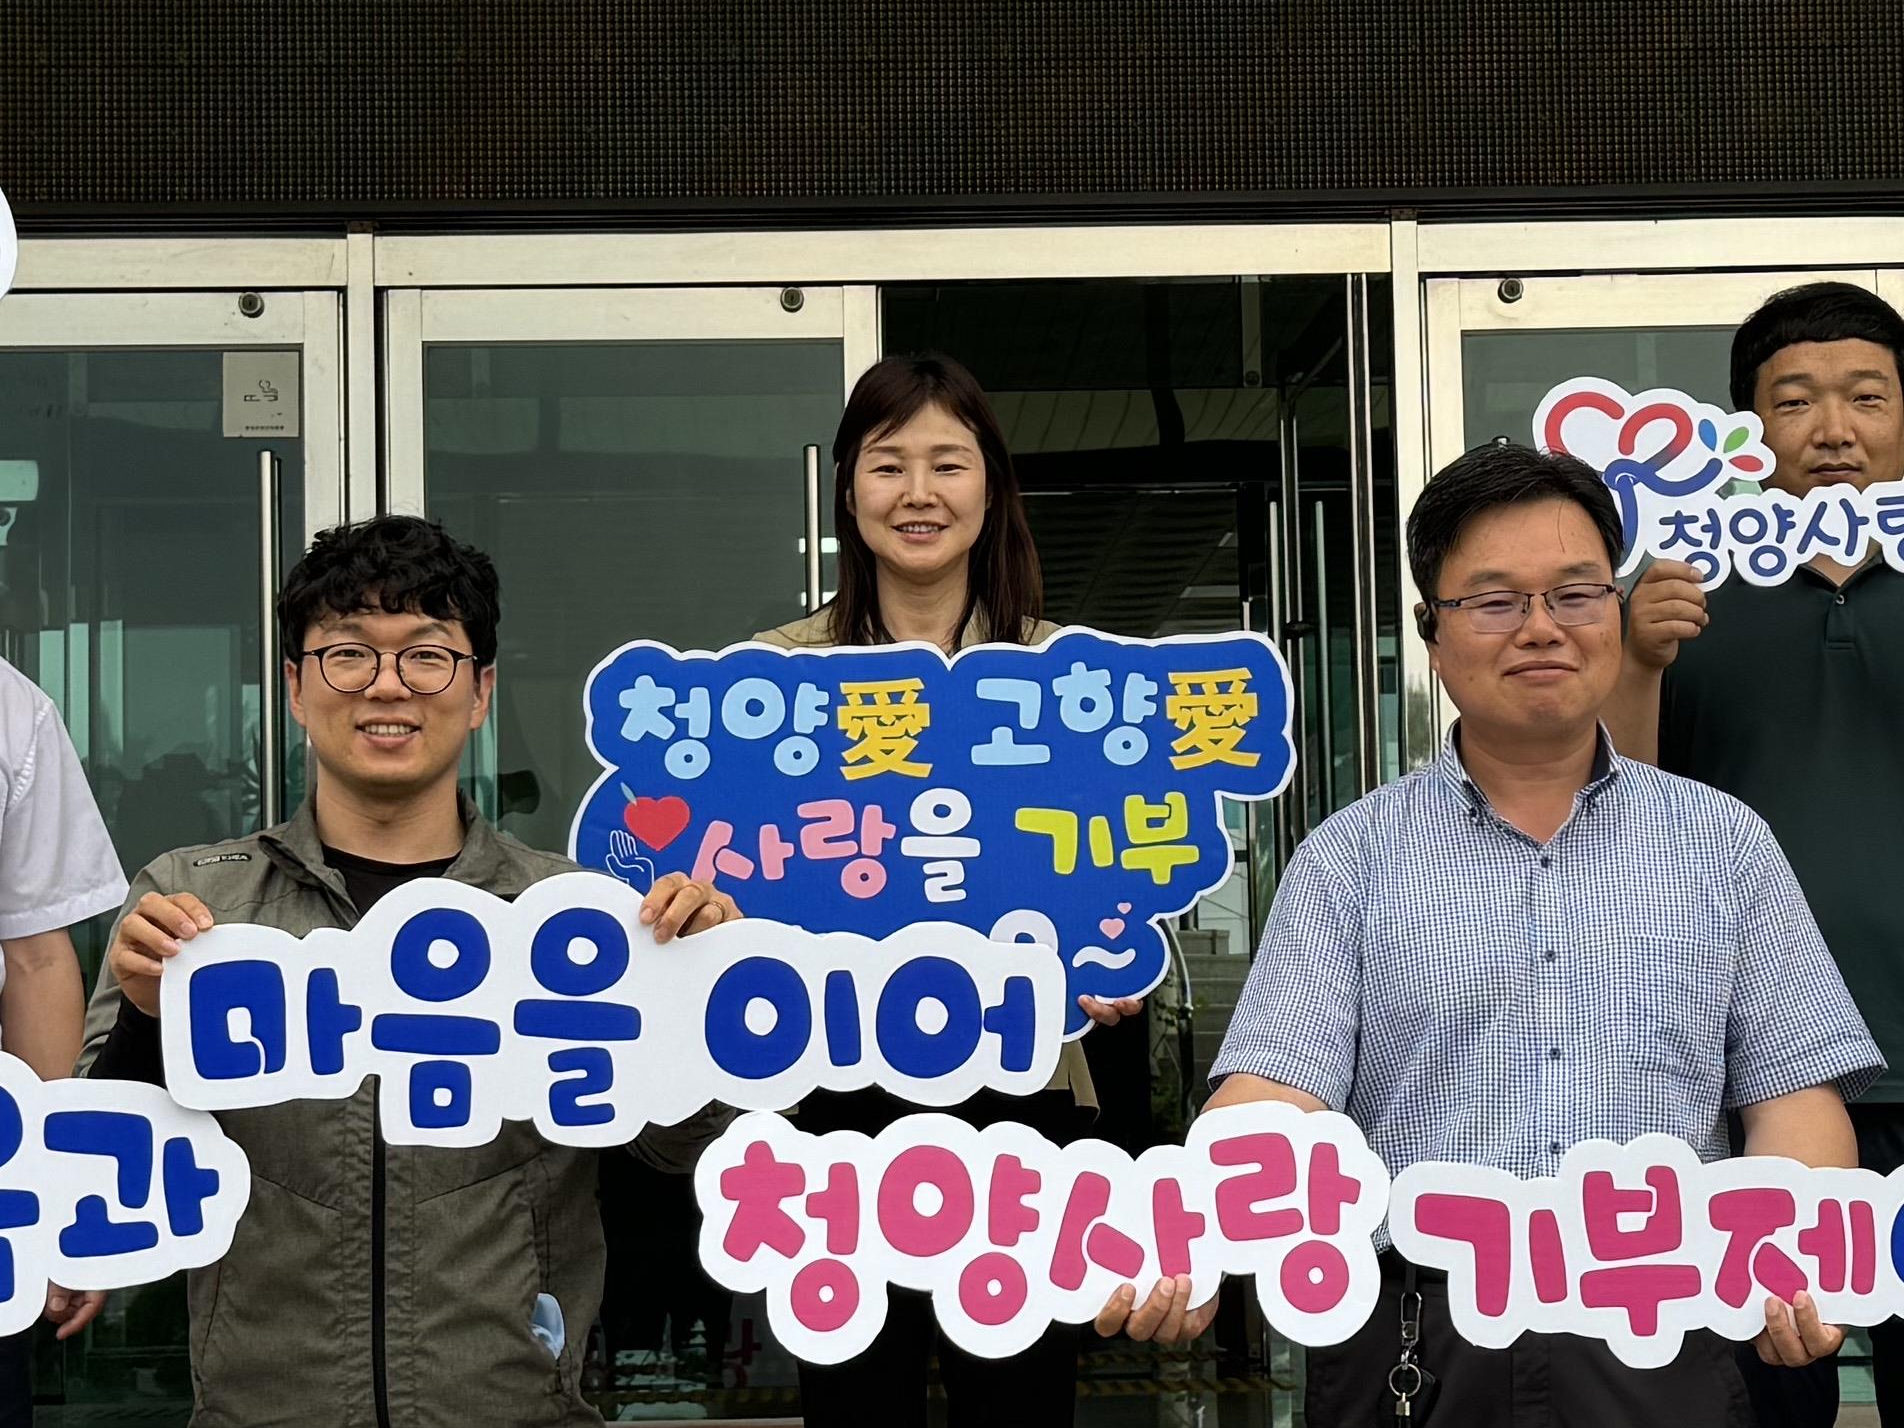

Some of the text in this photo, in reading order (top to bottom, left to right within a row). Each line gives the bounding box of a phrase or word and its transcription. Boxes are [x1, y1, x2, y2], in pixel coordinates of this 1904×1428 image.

[619, 662, 1256, 779] 청양愛 고향愛
[691, 788, 1197, 903] 사랑을 기부
[190, 908, 1035, 1128] 마음을 이어
[721, 1134, 1360, 1331] 청양사랑
